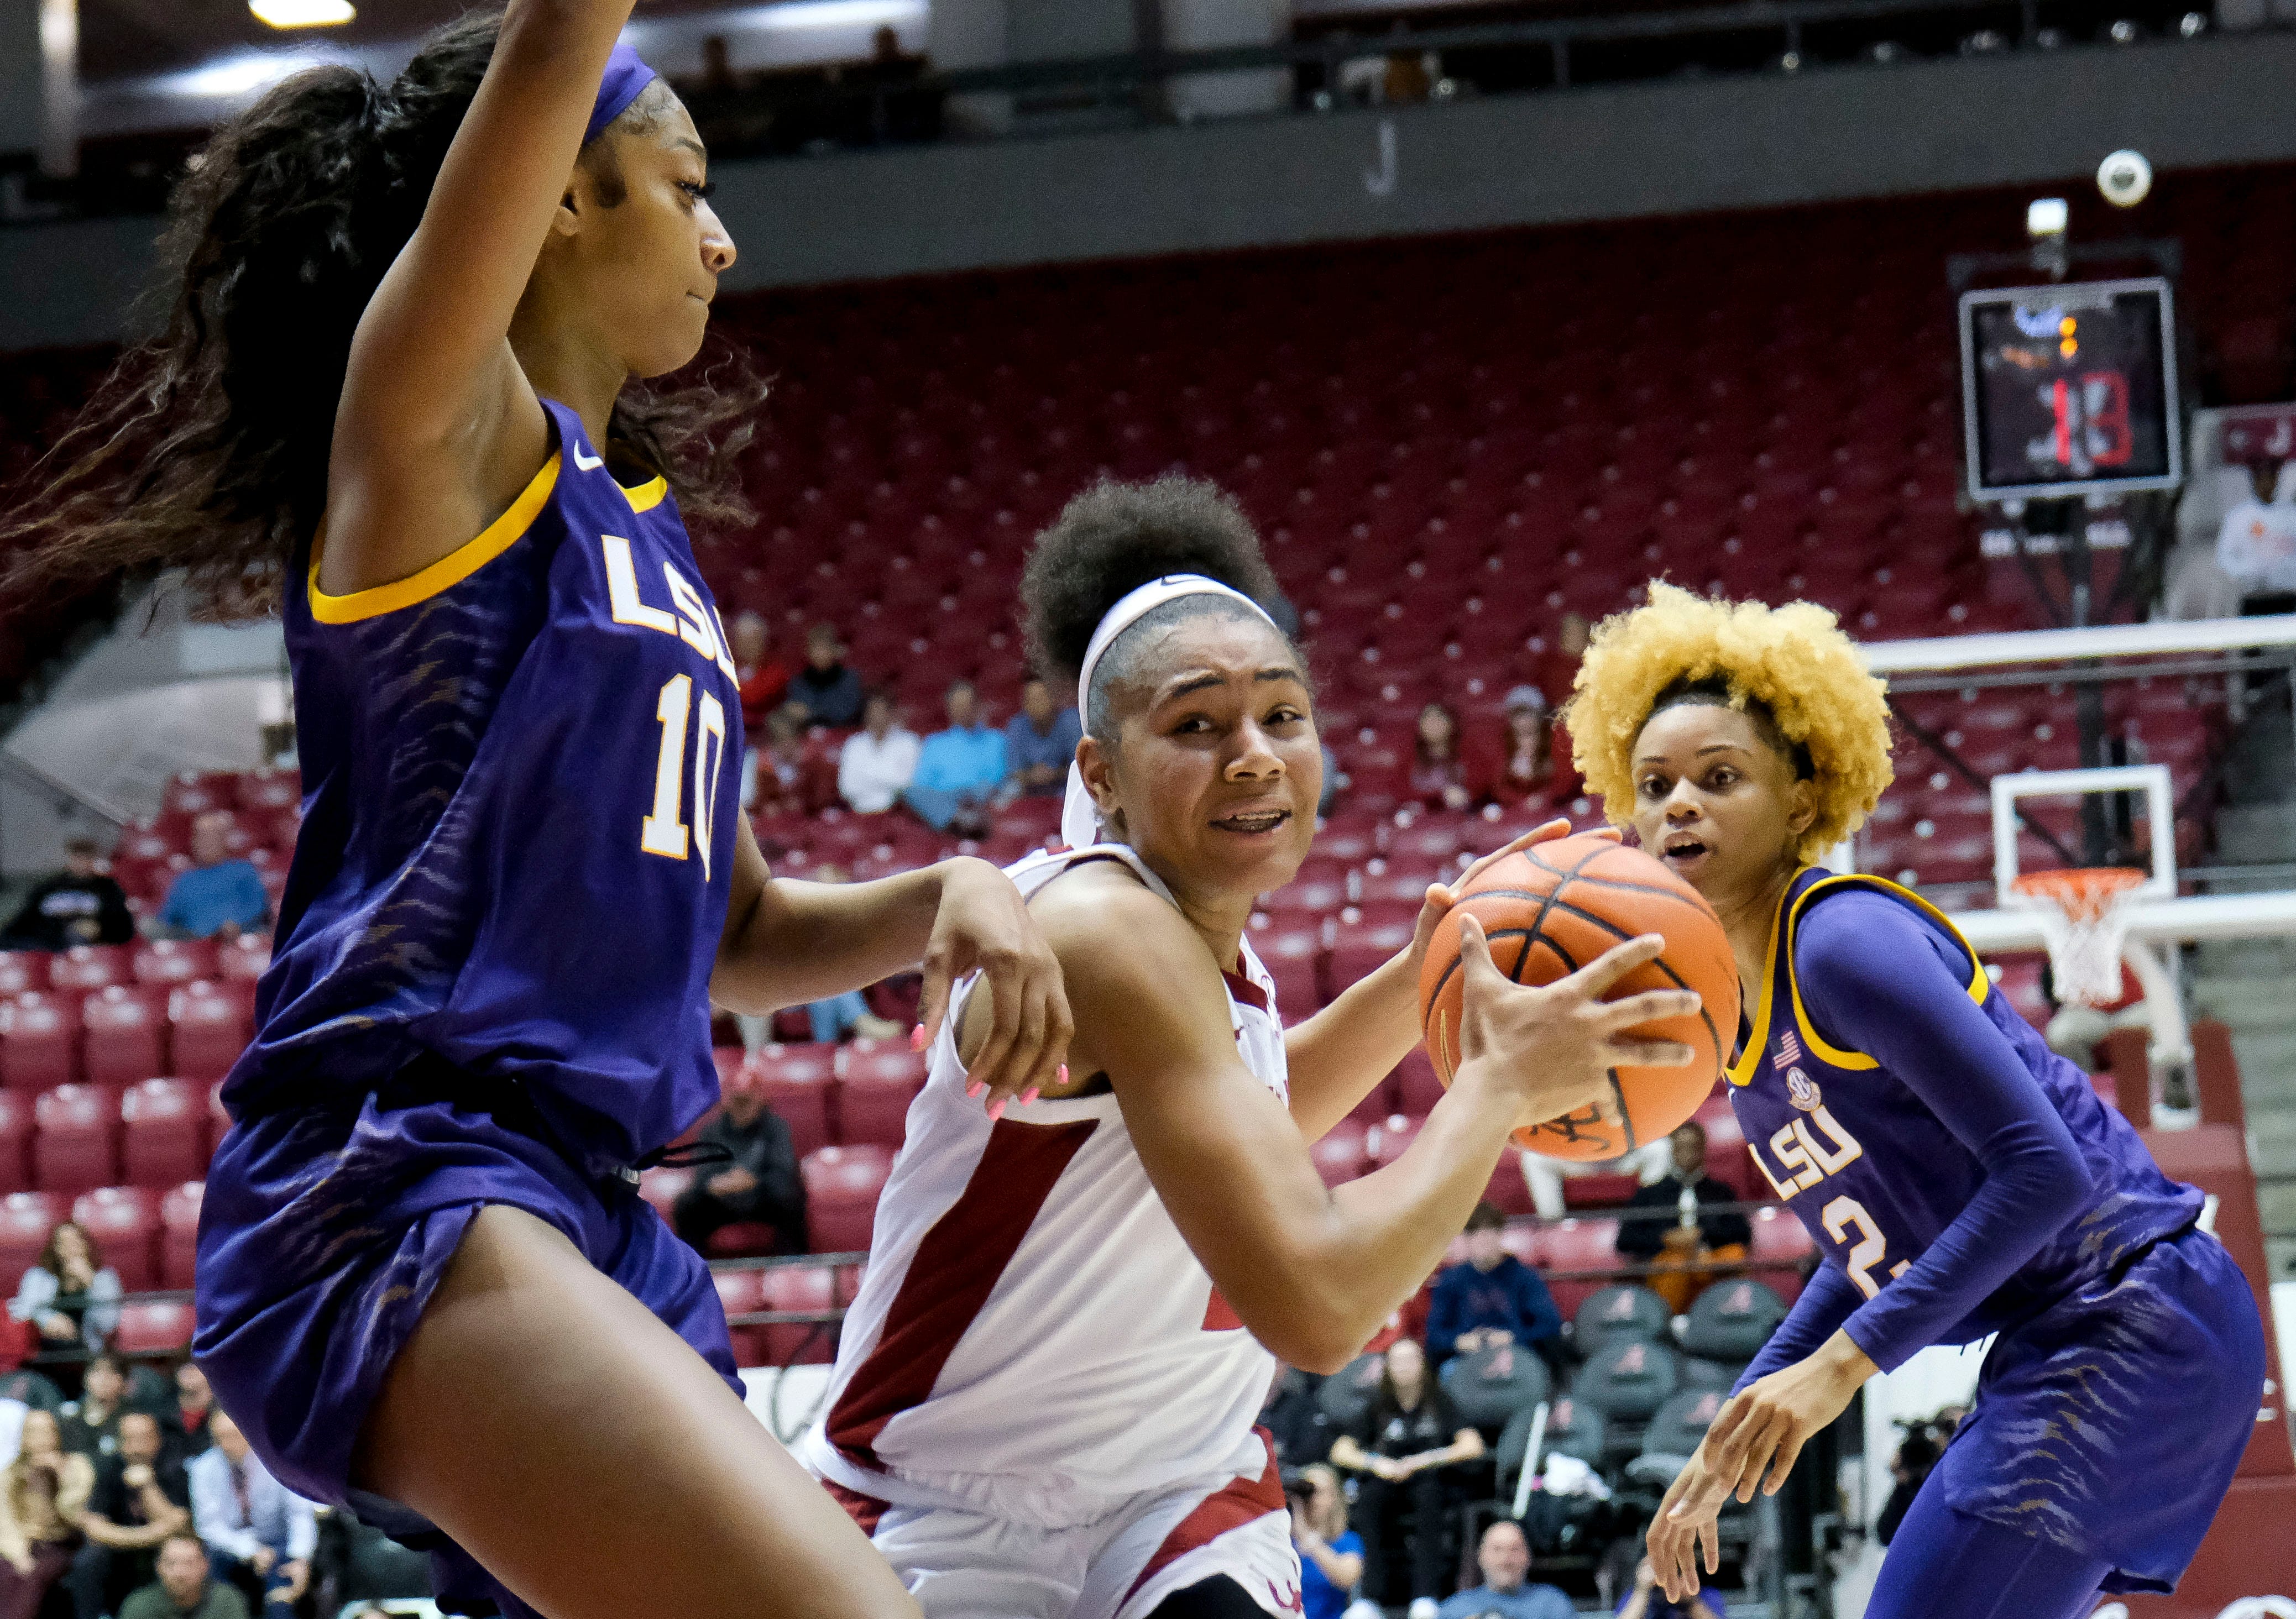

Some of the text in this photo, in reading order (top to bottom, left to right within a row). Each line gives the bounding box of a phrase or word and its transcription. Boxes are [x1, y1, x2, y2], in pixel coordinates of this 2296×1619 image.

[601, 535, 740, 691] LSU
[641, 673, 725, 882] 10
[1748, 1104, 1863, 1202] LSU
[1822, 1195, 1912, 1300] 2
